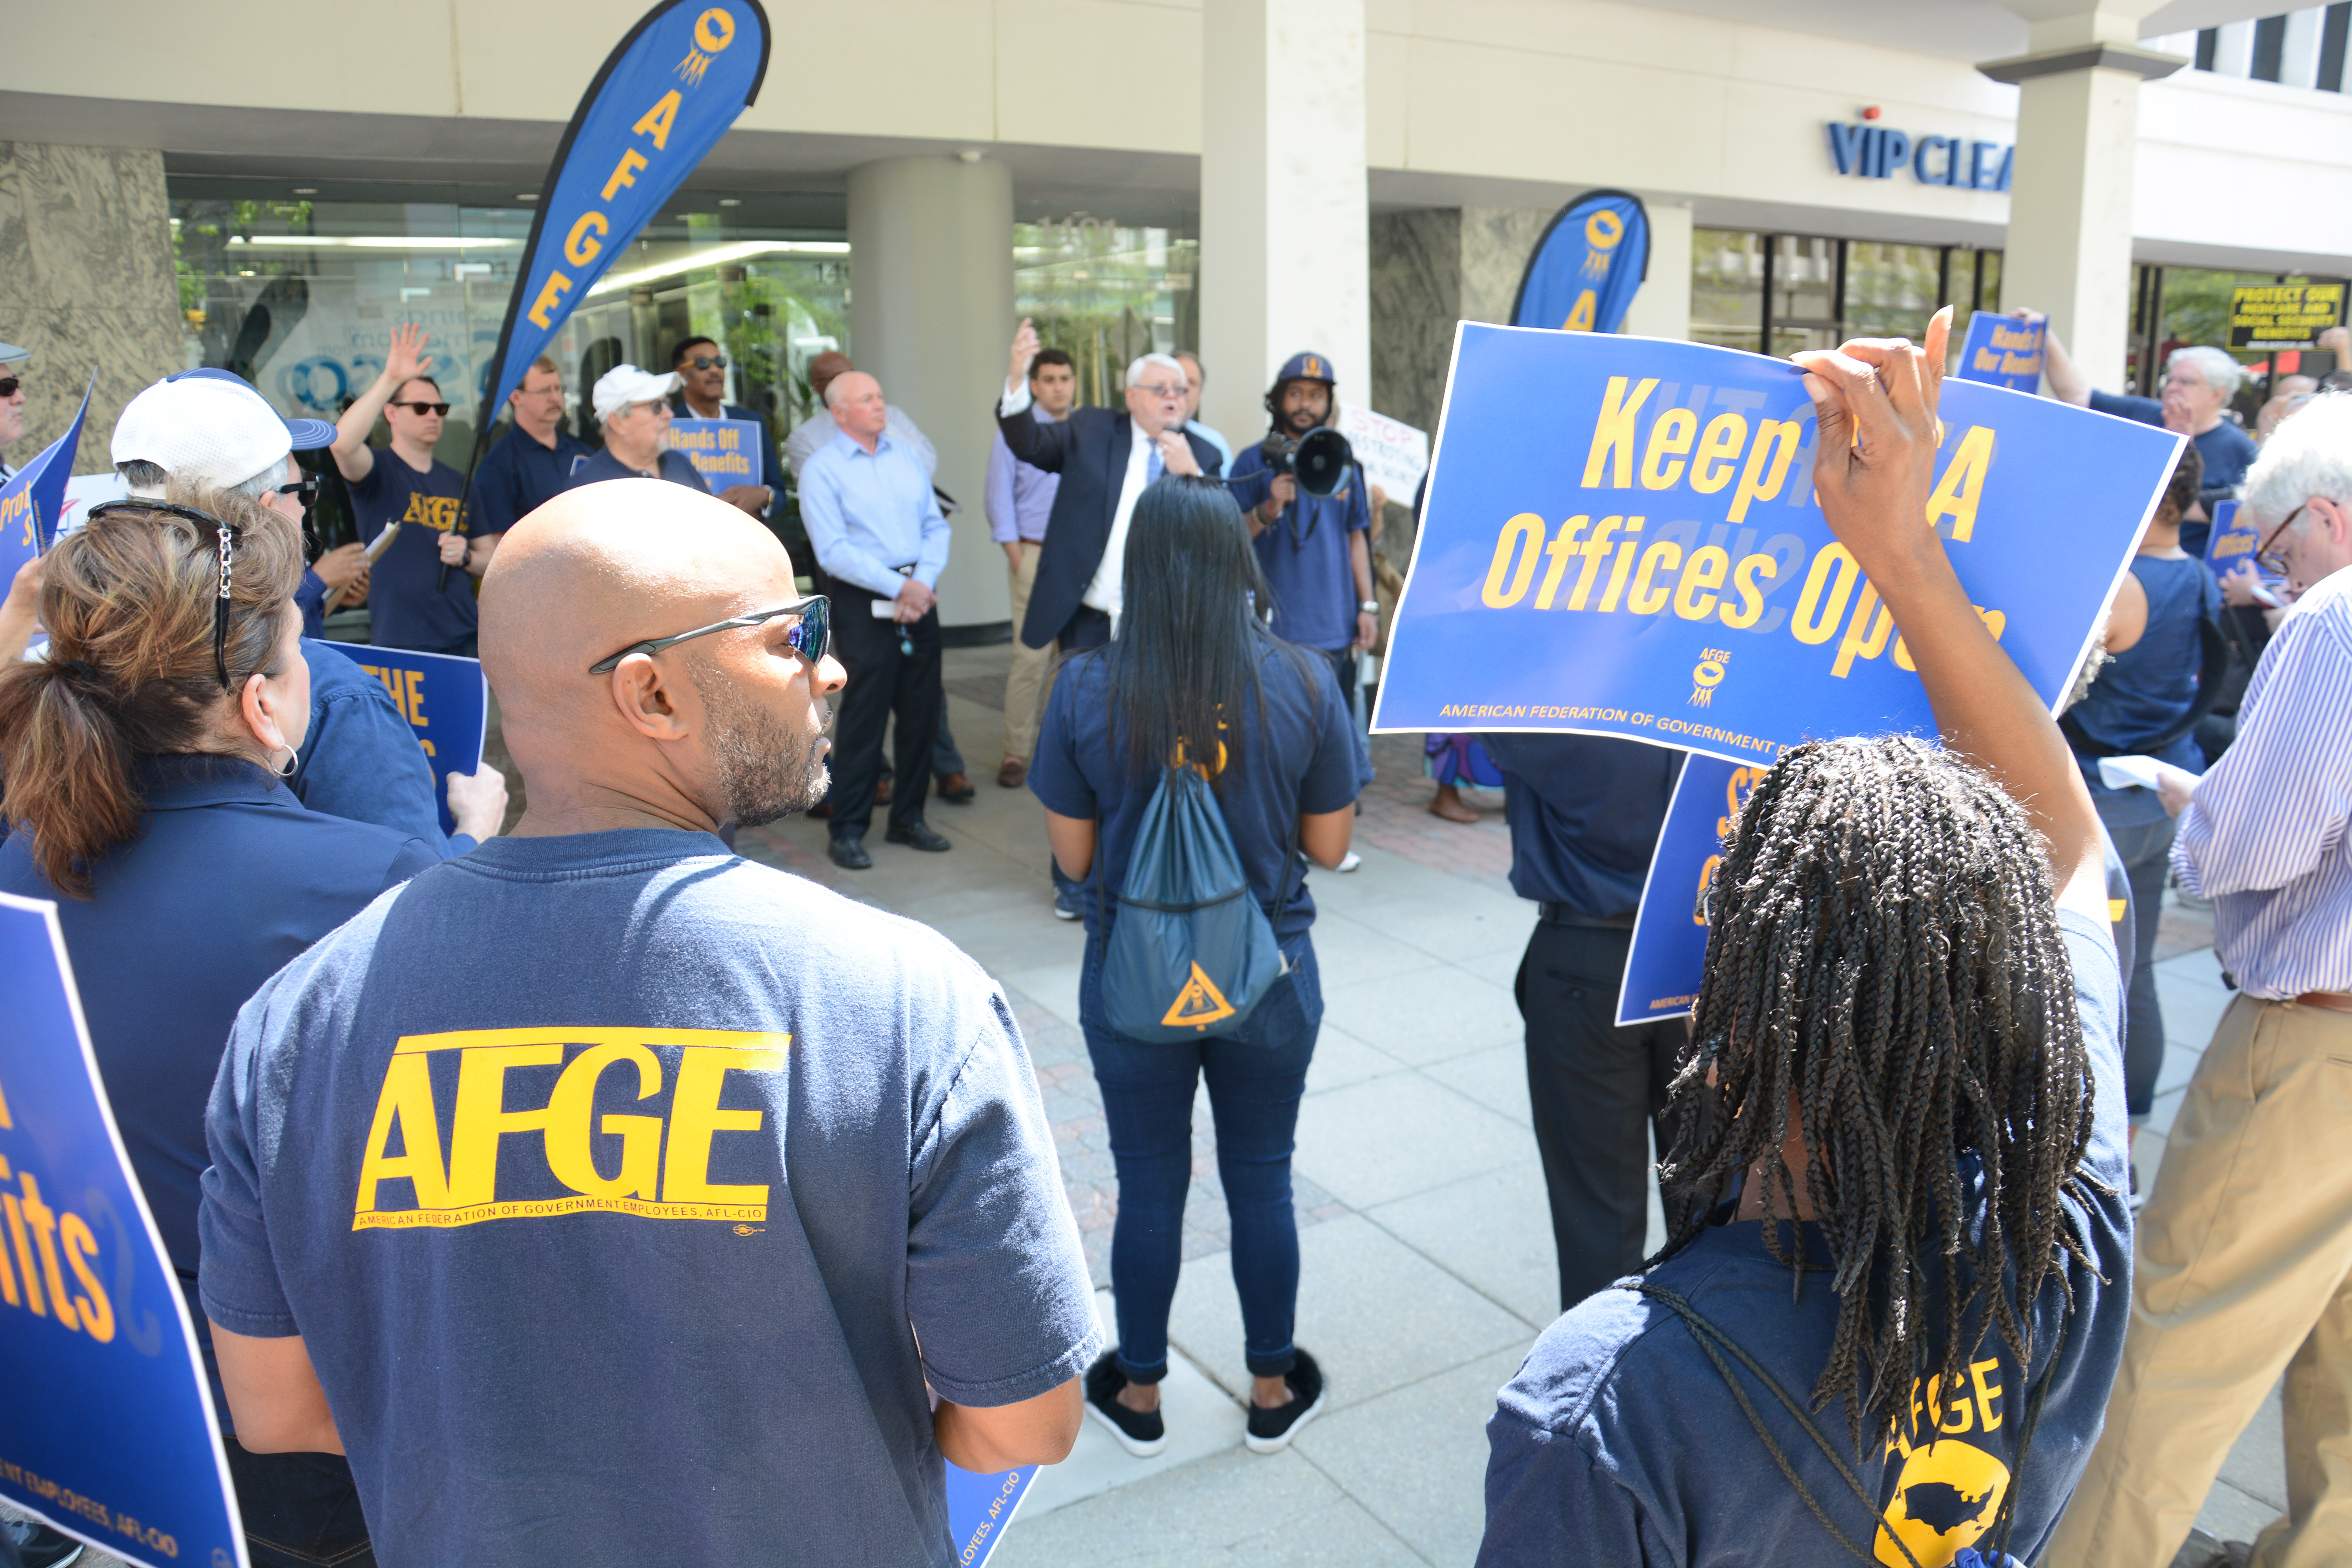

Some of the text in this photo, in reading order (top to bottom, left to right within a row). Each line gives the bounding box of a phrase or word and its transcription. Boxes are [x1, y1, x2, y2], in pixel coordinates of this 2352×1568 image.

[1826, 122, 1910, 179] VIP
[527, 89, 682, 331] AFGE
[670, 427, 740, 450] Hands Off
[1351, 409, 1413, 447] STOP
[1580, 376, 1802, 524] Keep
[1481, 512, 1778, 630] Offices
[1699, 647, 1732, 664] AFGE
[1439, 704, 1526, 717] AMERICAN
[1529, 705, 1628, 722] FEDERATION
[1631, 712, 1655, 726] OF
[1657, 717, 1776, 753] GOVERNMENT
[355, 1043, 788, 1213] AFGE
[359, 1199, 762, 1226] AMERICAN FEDERATION OF GOVERNMENT EMPLOYEES, AFL-CIO
[989, 1472, 1020, 1520] AFL-CIO
